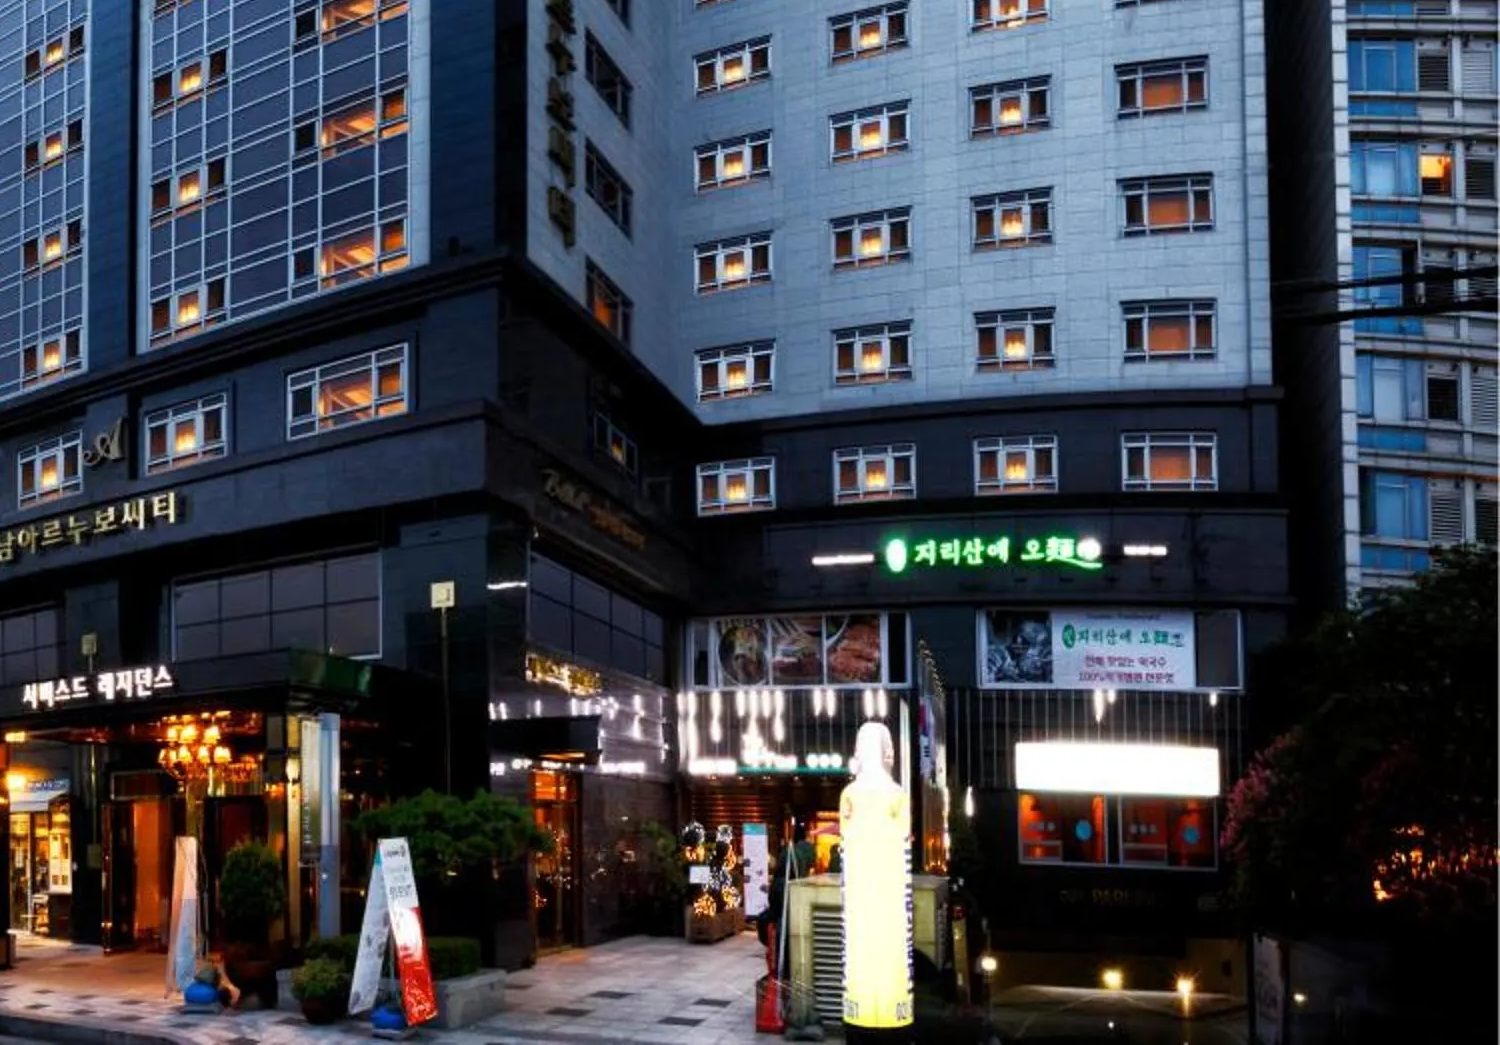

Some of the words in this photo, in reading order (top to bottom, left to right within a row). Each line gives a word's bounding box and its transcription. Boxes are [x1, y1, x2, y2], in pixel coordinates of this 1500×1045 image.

[914, 537, 1010, 566] 지리산에
[1077, 627, 1132, 645] 지리산에
[97, 665, 174, 700] 레지던스
